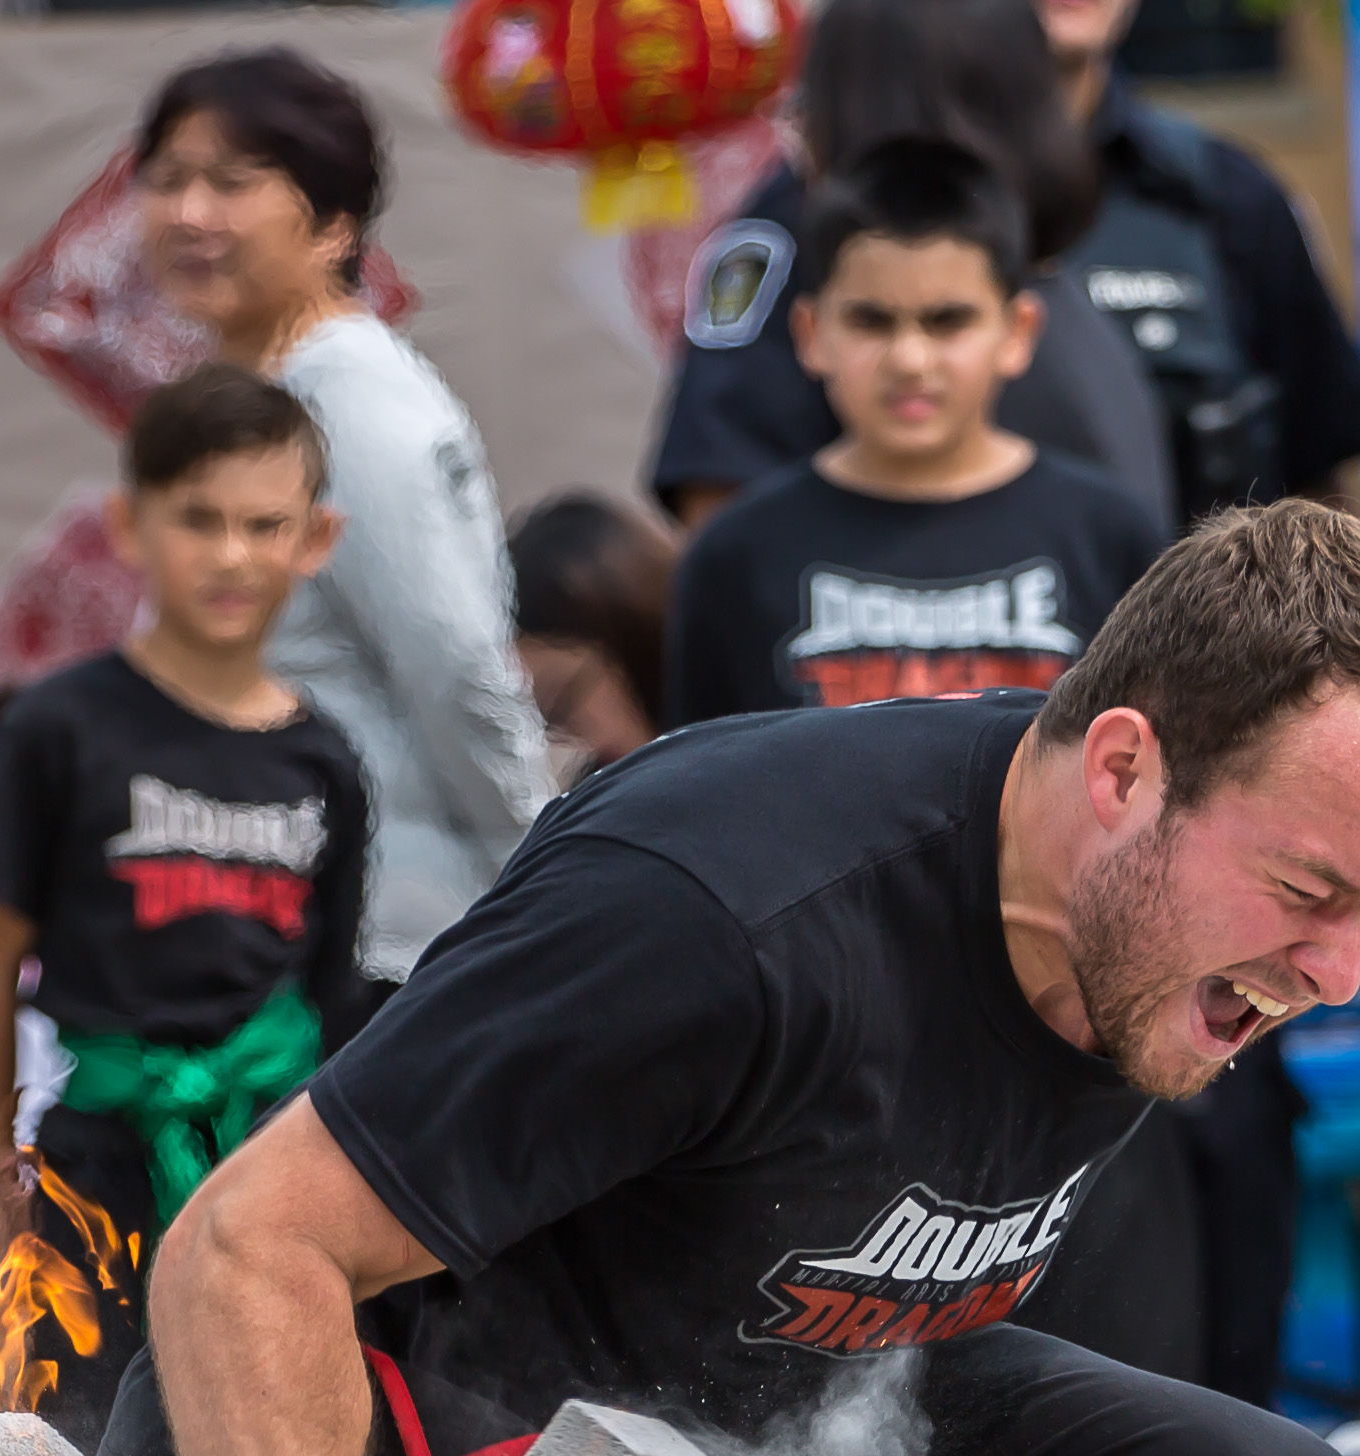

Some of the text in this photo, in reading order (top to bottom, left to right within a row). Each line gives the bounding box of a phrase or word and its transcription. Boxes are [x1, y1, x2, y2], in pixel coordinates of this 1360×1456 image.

[799, 1163, 1088, 1281] DOUBLE
[770, 1260, 1044, 1349] DRAGON
[790, 1268, 954, 1302] MARTIAL ARTS
